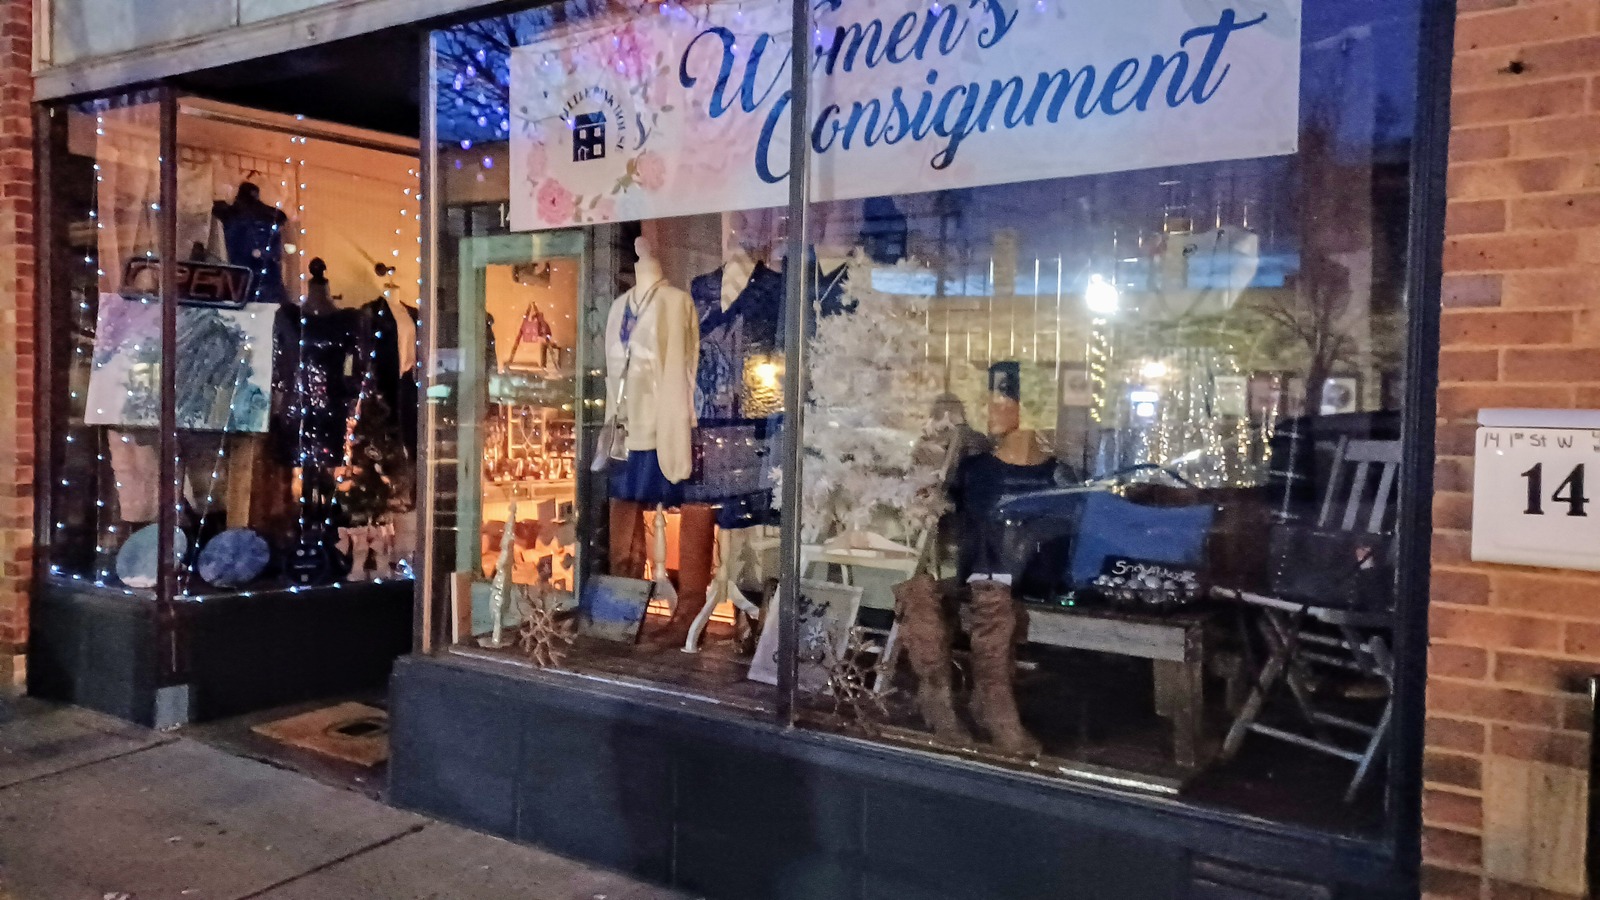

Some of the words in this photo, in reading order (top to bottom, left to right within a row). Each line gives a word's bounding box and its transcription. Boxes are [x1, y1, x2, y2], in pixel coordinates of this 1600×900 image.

[755, 8, 1268, 184] Consignment
[125, 261, 249, 303] OPEN
[1483, 432, 1500, 448] 14
[1529, 433, 1548, 448] St
[1557, 435, 1574, 448] W
[1520, 462, 1590, 517] 14
